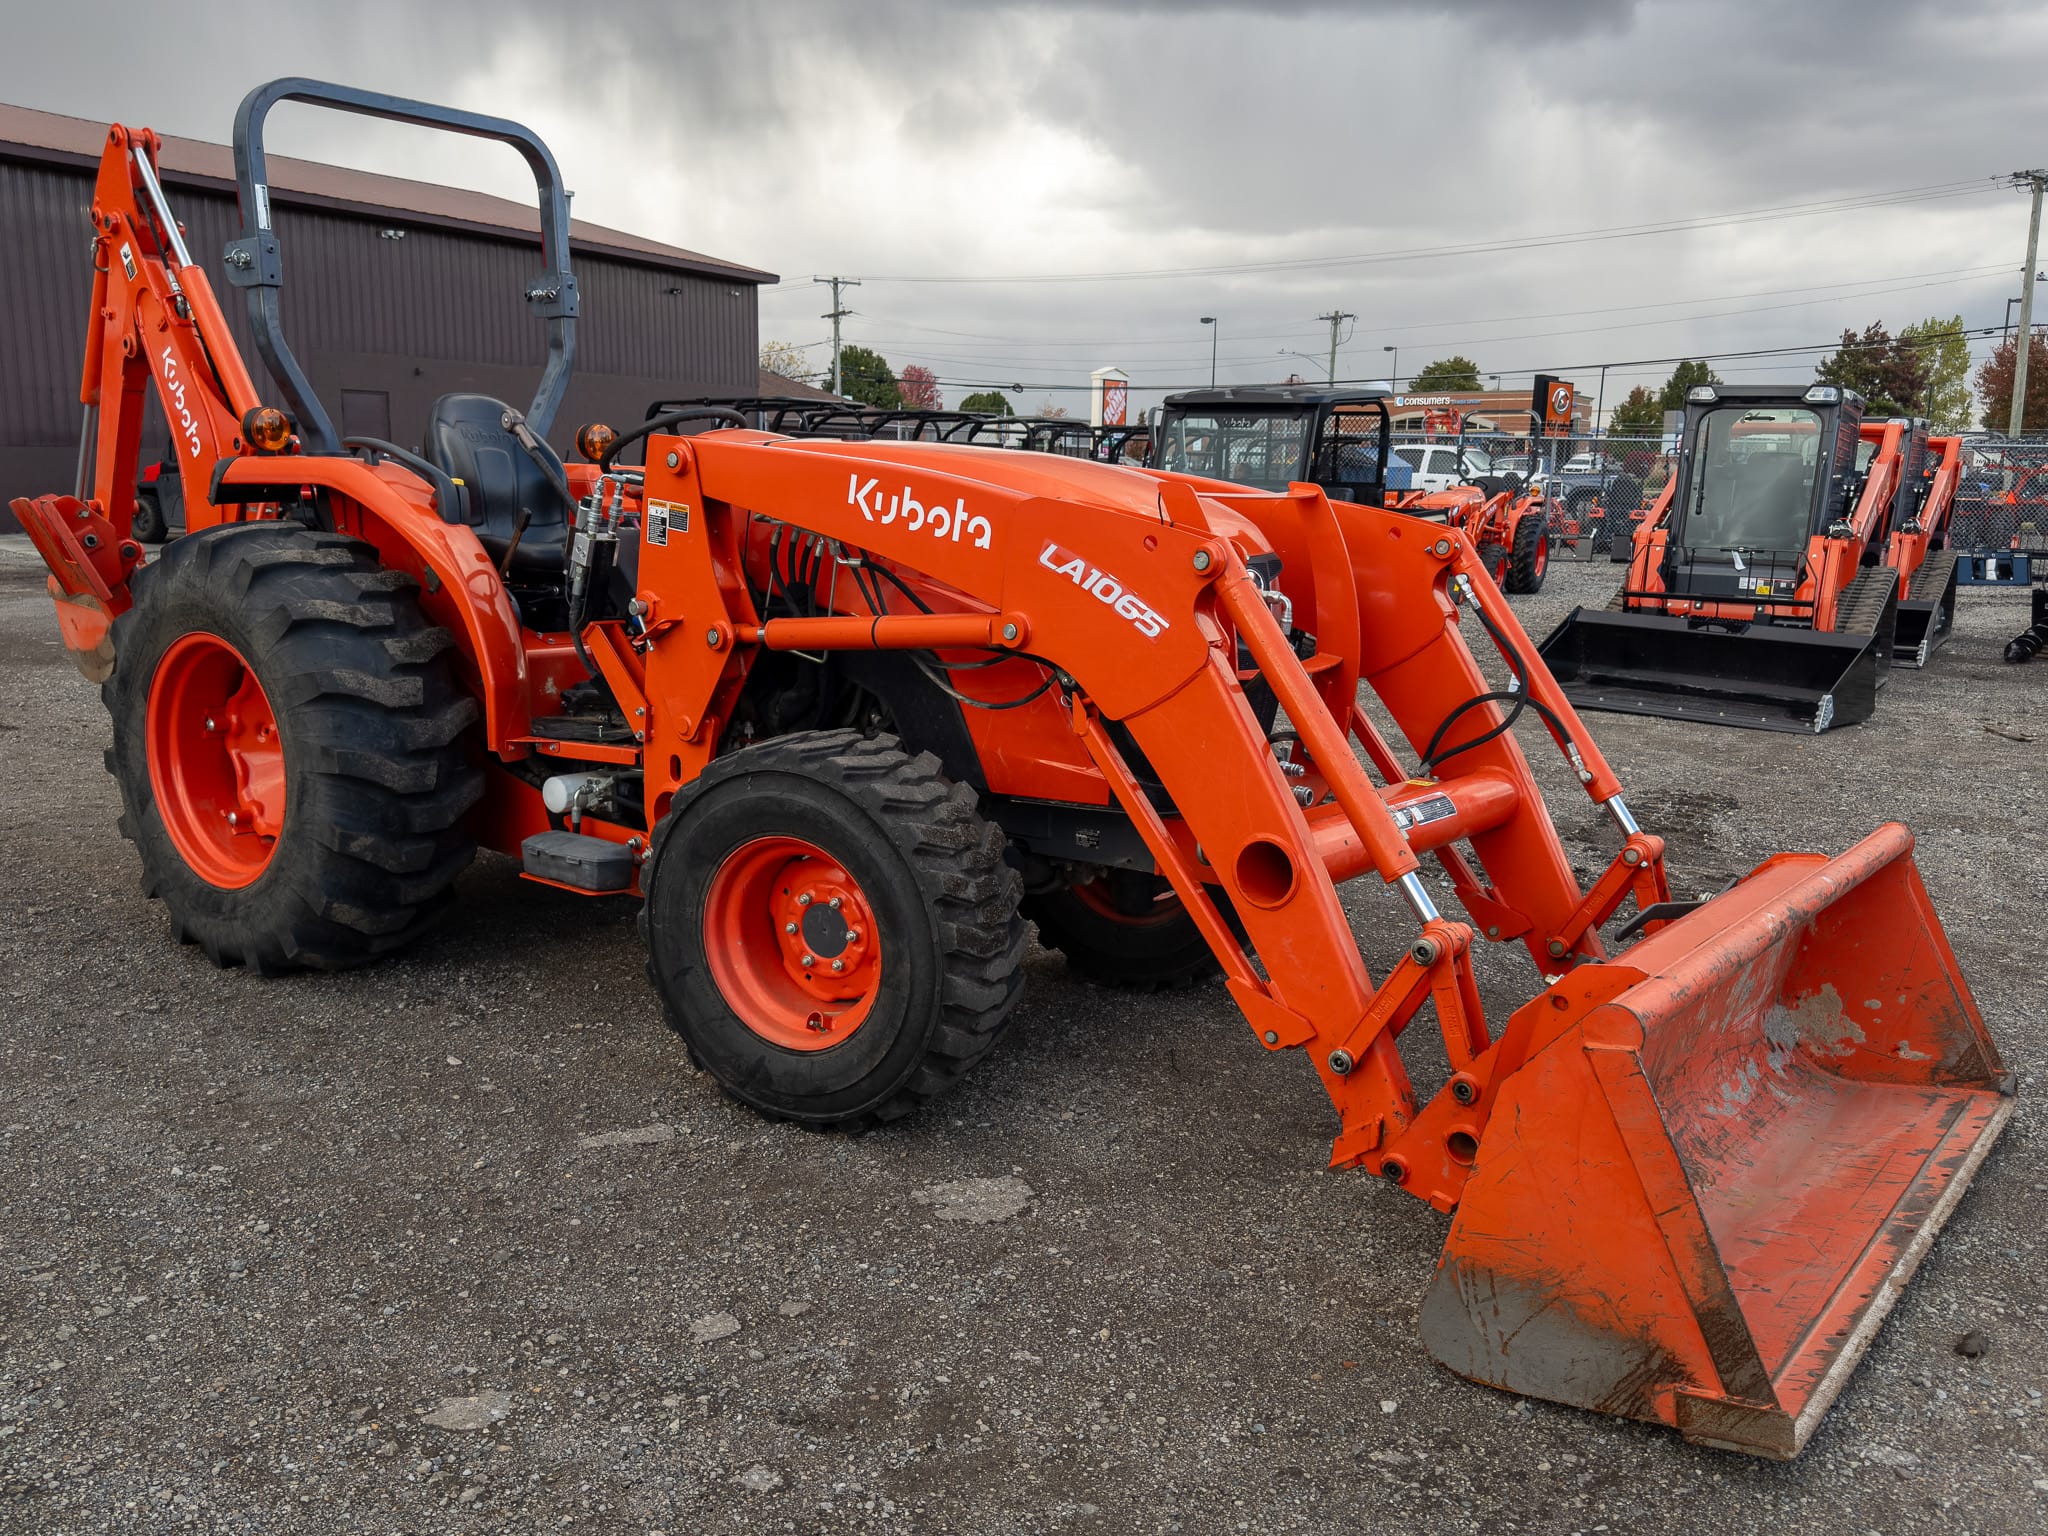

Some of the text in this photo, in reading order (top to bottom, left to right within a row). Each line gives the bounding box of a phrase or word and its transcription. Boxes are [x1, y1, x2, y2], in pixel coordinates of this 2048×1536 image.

[161, 346, 201, 458] Kubota
[1404, 396, 1451, 406] consumers
[847, 473, 993, 550] Kubota
[1039, 543, 1170, 638] LA1065
